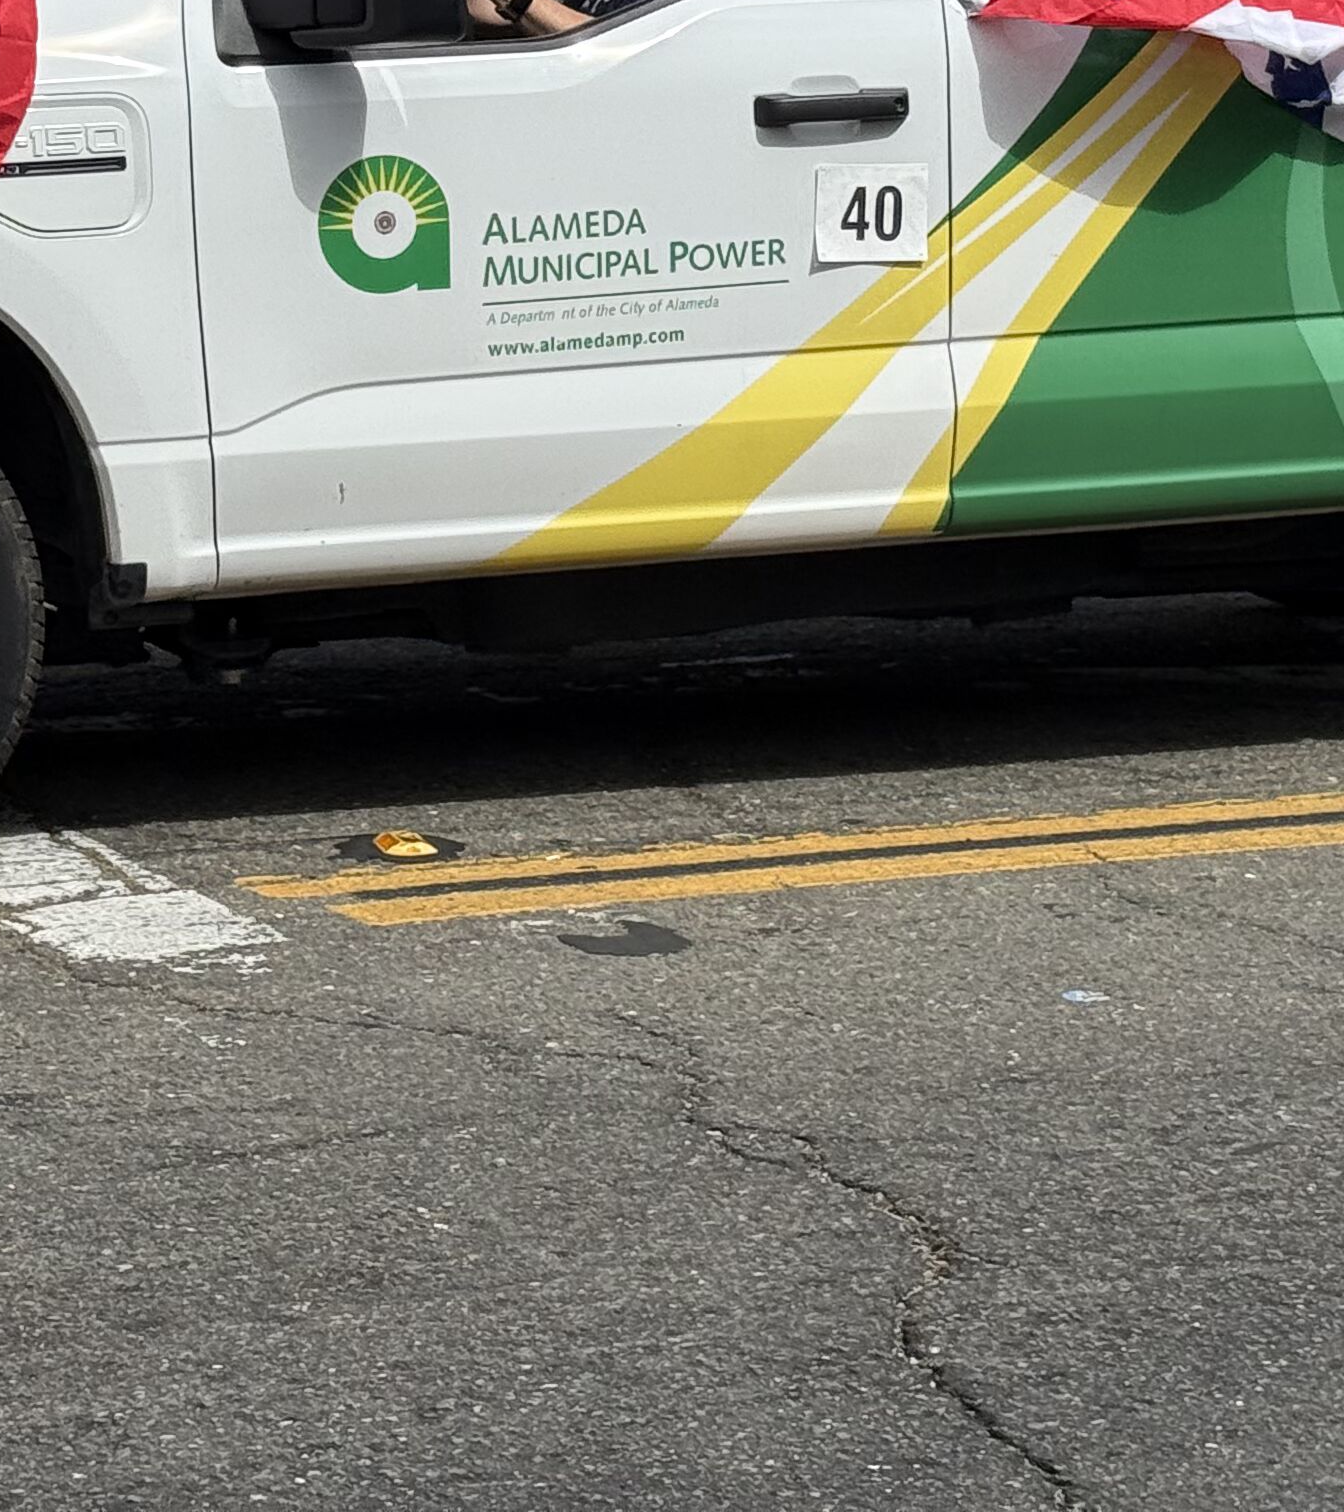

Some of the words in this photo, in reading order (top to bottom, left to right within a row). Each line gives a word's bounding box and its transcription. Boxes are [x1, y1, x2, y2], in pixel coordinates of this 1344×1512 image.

[14, 121, 128, 158] -150
[482, 207, 647, 246] ALAMEDA
[840, 185, 903, 242] 40
[482, 247, 659, 288] MUNICIPAL
[669, 238, 787, 274] POWER
[486, 312, 497, 326] A
[500, 305, 576, 327] Departmnt
[578, 303, 594, 319] of
[595, 303, 617, 318] the
[619, 300, 645, 317] City
[648, 298, 663, 313] of
[665, 294, 720, 312] Alameda
[487, 327, 685, 357] www.alamedamp.com
